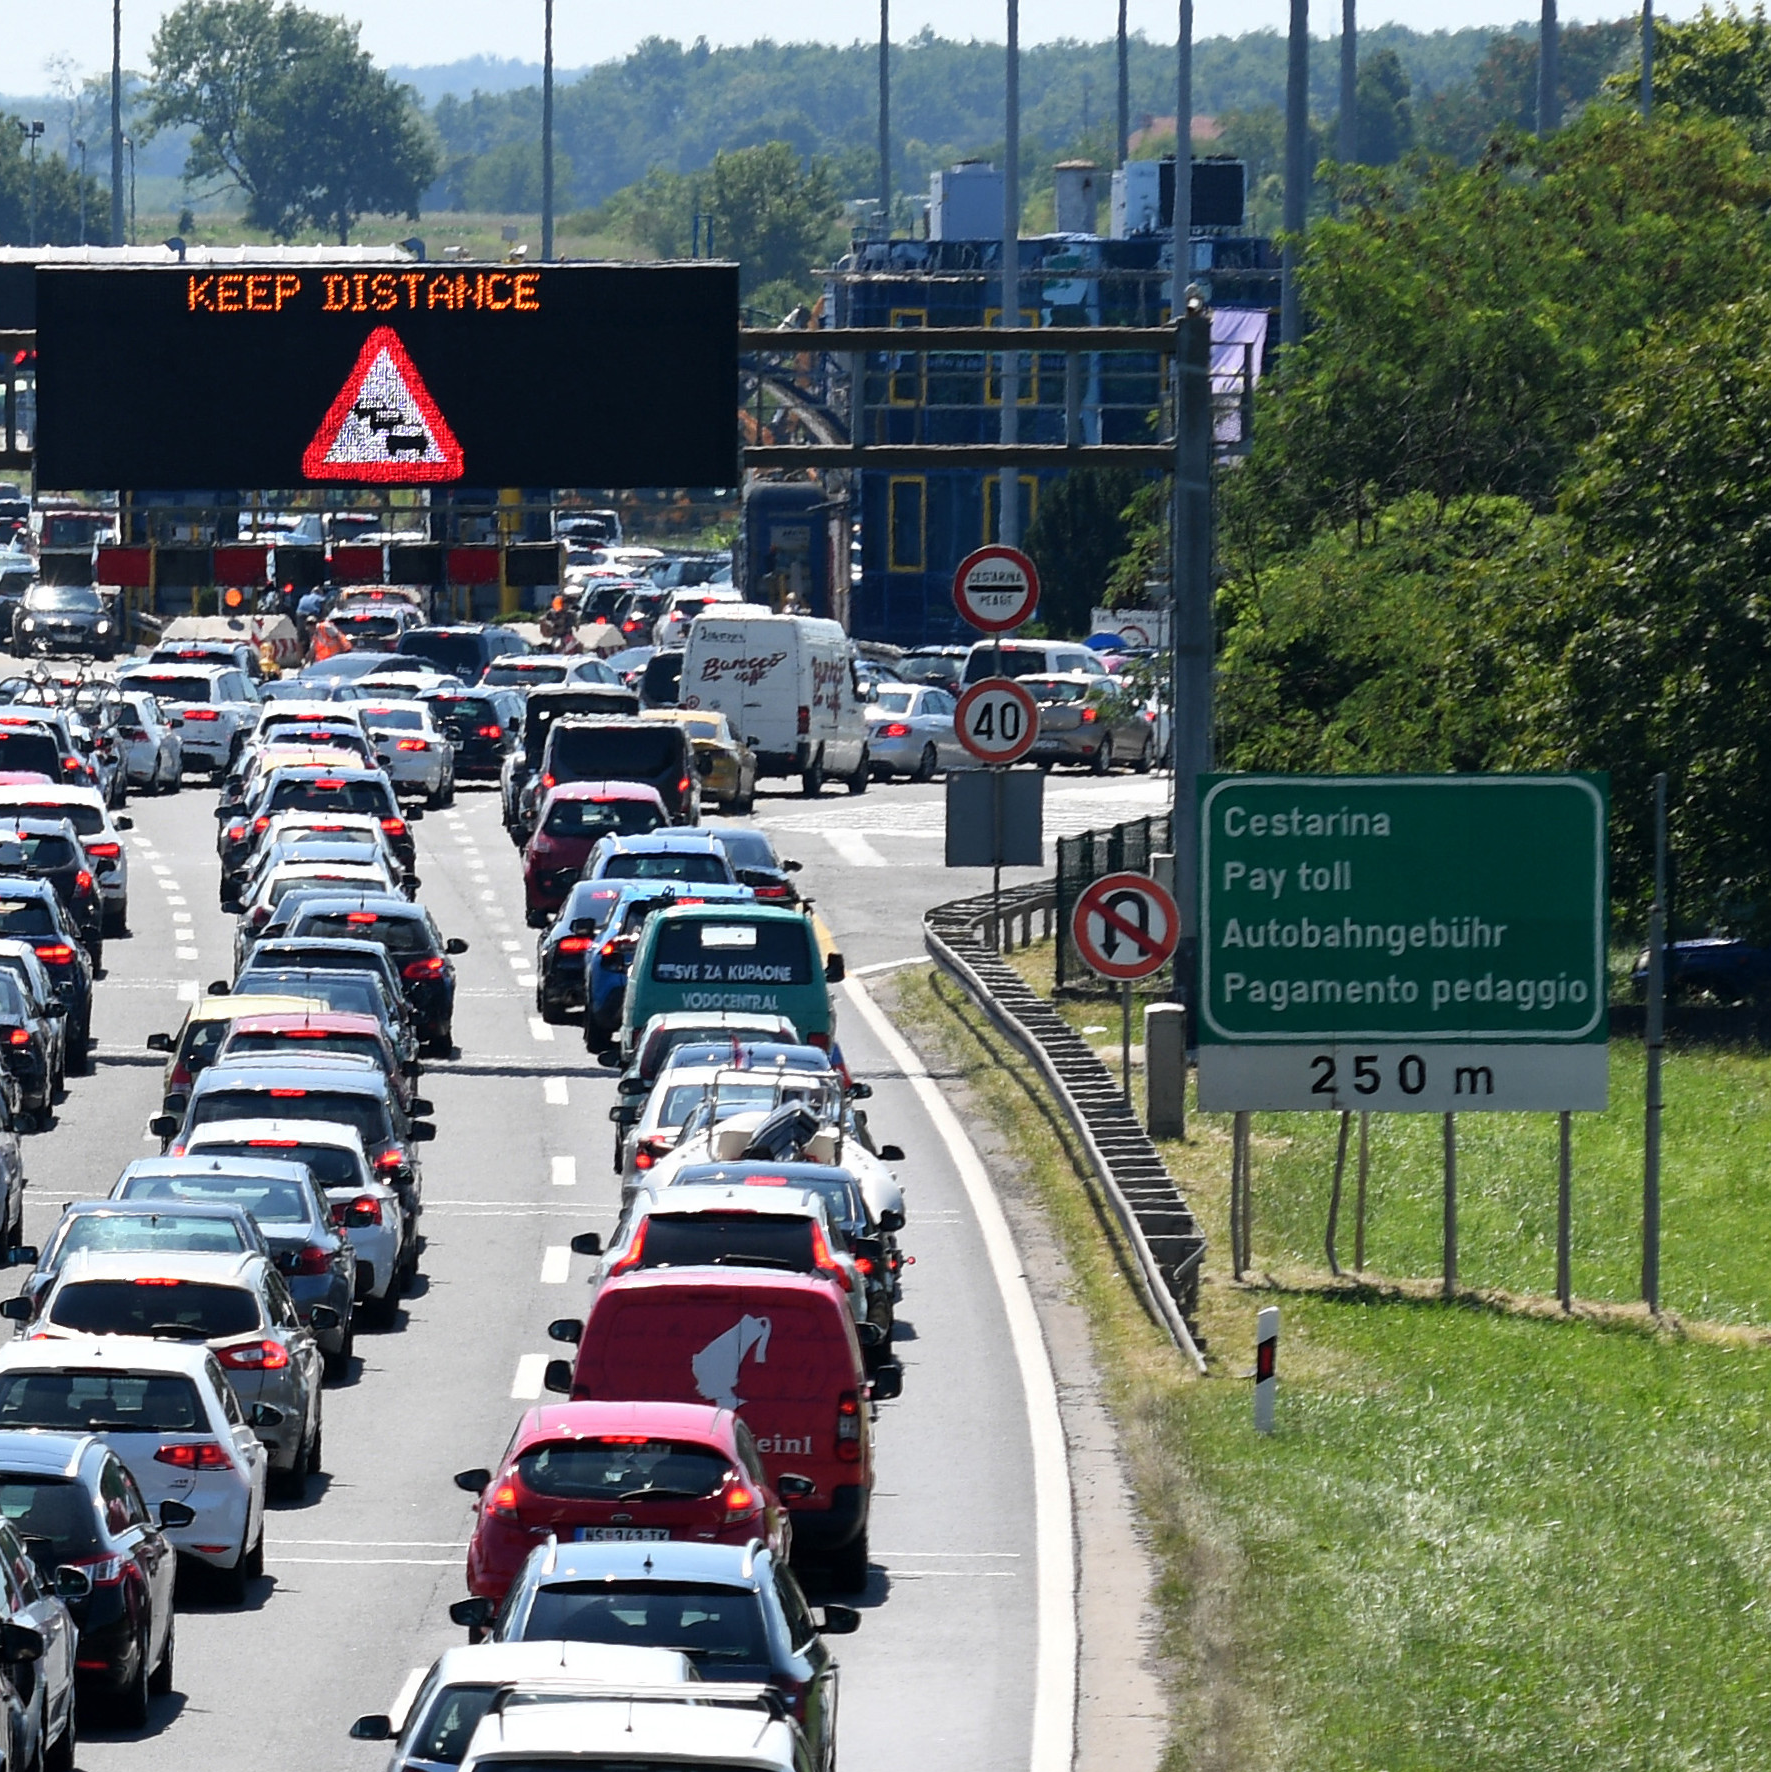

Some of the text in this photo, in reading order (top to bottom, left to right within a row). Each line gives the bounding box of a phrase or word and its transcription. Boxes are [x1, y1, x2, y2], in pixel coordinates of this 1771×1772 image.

[187, 272, 541, 312] KEEP DISTANCE
[969, 572, 1022, 582] CESTARINA
[973, 702, 1020, 741] 40
[1223, 805, 1391, 838] Cestarina
[1223, 861, 1353, 898] Pay toll
[1221, 917, 1508, 956] Autobahngebühr
[705, 965, 724, 980] ZA
[682, 992, 779, 1011] VODOCENTRAL
[1223, 972, 1588, 1011] Pagamento pedaggio
[1311, 1055, 1495, 1095] 250 m
[753, 1435, 814, 1455] einl
